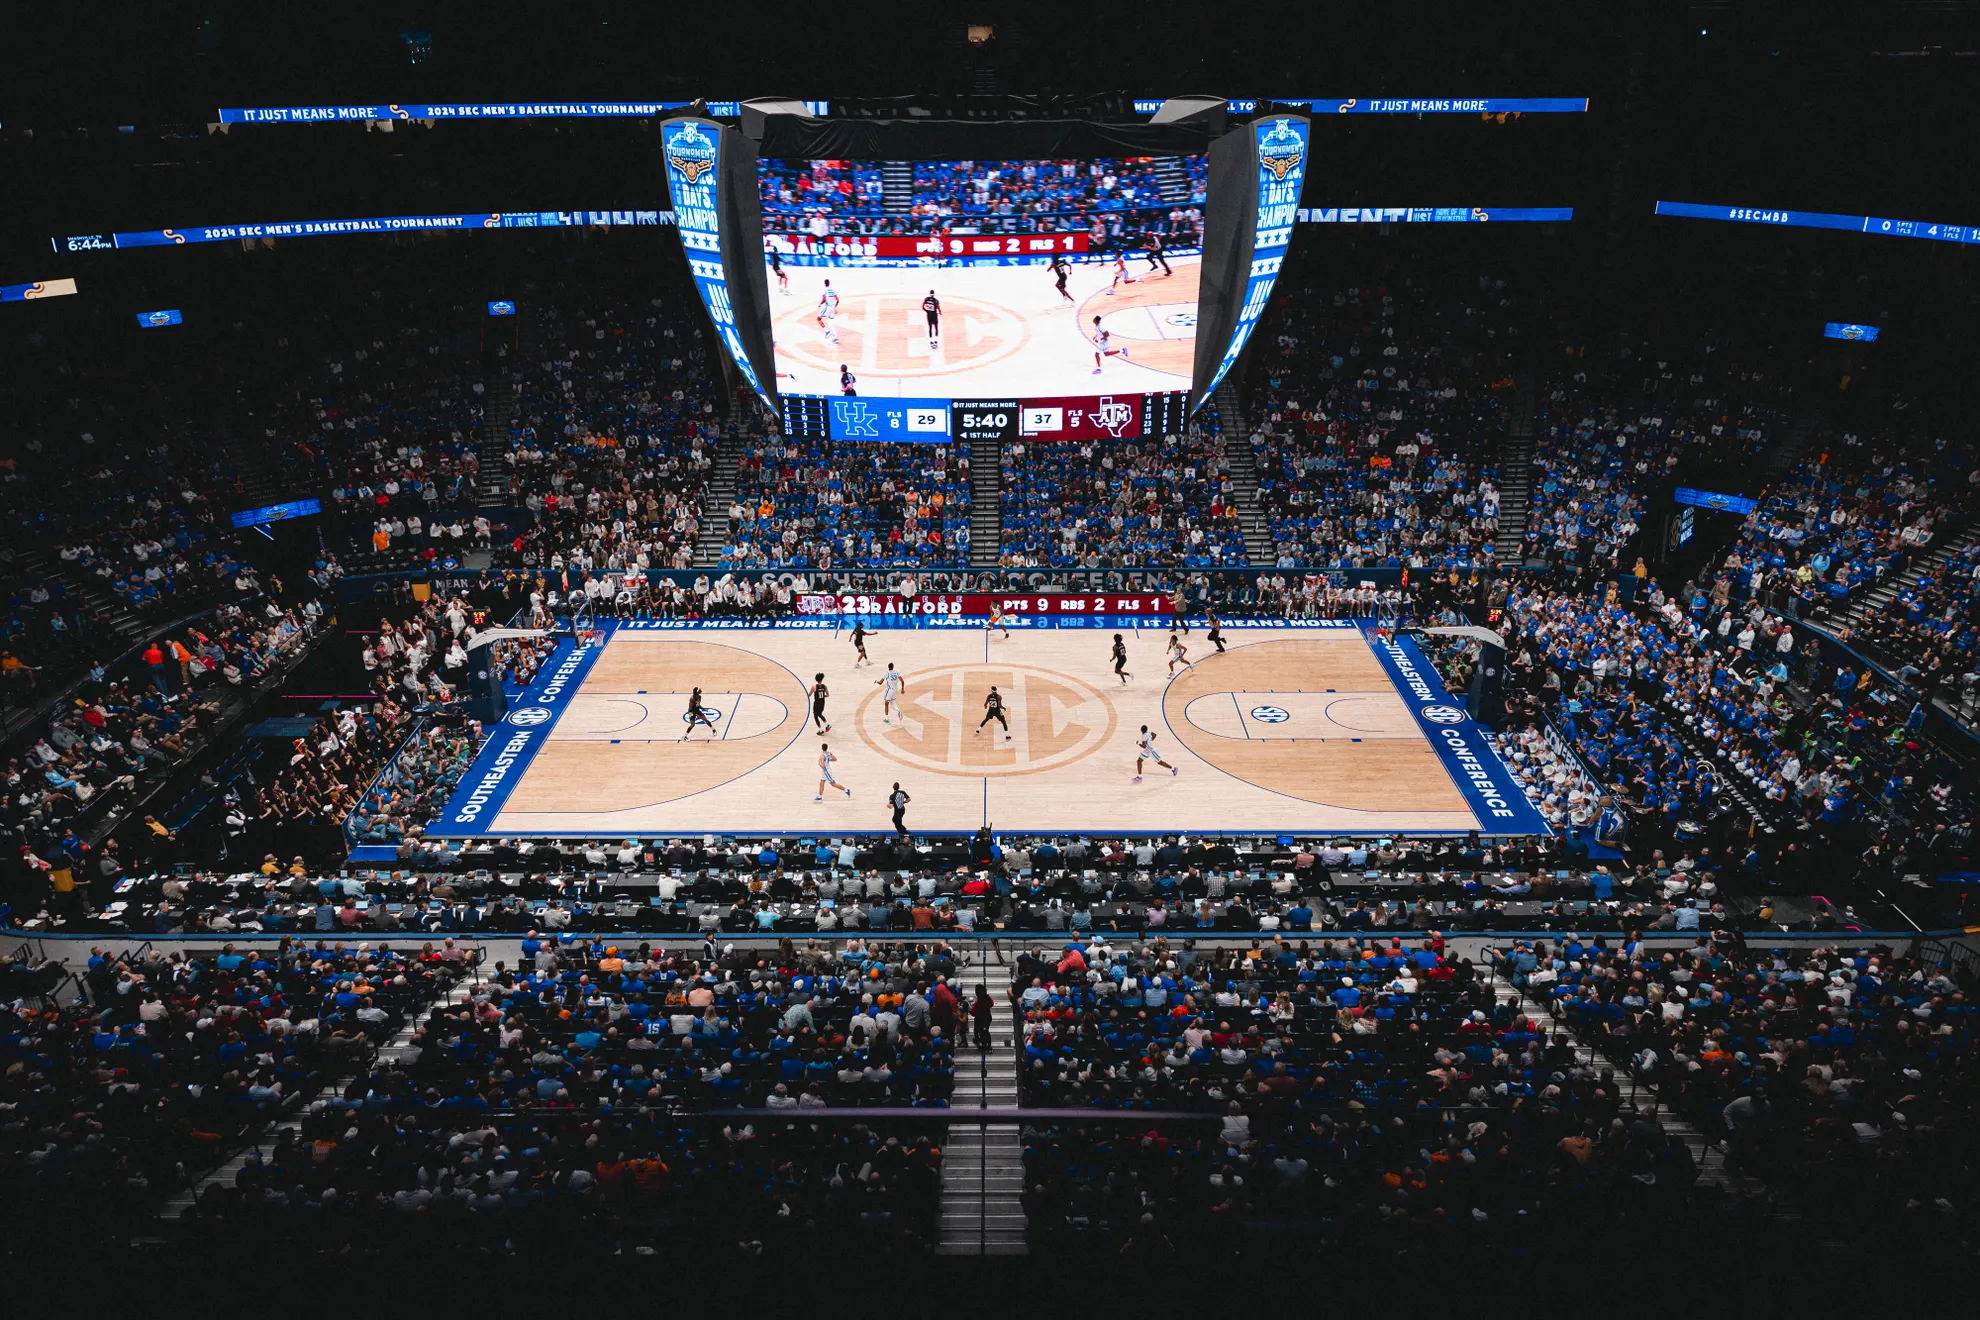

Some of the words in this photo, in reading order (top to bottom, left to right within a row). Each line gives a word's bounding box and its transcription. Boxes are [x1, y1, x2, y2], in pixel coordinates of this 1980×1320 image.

[428, 106, 455, 116] 2024
[459, 106, 478, 116] SEC
[482, 105, 517, 115] MEN'S
[519, 105, 588, 115] BASKETBALL
[591, 104, 663, 115] TOURNAMENT
[1370, 101, 1380, 111] IT
[1381, 101, 1408, 111] JUST
[1411, 101, 1449, 111] MEANS
[244, 110, 255, 120] IT
[258, 109, 288, 120] JUST
[292, 108, 335, 119] MEANS
[682, 184, 714, 208] DAYS.
[1268, 181, 1295, 205] DAYS.
[1729, 209, 1788, 223] #SECMBB
[205, 228, 236, 238] 2024
[240, 226, 262, 236] SEC
[266, 224, 302, 234] MEN'S
[306, 221, 381, 232] BASKETBALL
[385, 217, 463, 228] TOURNAMENT
[1882, 221, 1891, 231] 0
[1928, 226, 1938, 235] 4
[950, 240, 964, 253] 9
[1006, 238, 1020, 252] 2
[1062, 236, 1075, 250] 1
[890, 418, 900, 429] 8
[918, 415, 936, 425] 29
[963, 413, 1008, 428] 5:40
[1034, 414, 1052, 424] 37
[1070, 417, 1080, 428] 5
[842, 596, 870, 614] 23
[1004, 600, 1028, 610] PTS
[1037, 598, 1048, 611] 9
[1060, 600, 1086, 610] RBS
[1094, 598, 1105, 611] 2
[1118, 600, 1140, 610] FLS
[1150, 598, 1160, 610] 1
[511, 708, 550, 726] SEC
[882, 670, 1090, 767] SEC
[1423, 705, 1463, 723] SEC
[455, 731, 533, 823] SOUTHEASTERN
[1441, 730, 1514, 817] CONFERENCE
[648, 1023, 660, 1034] 15
